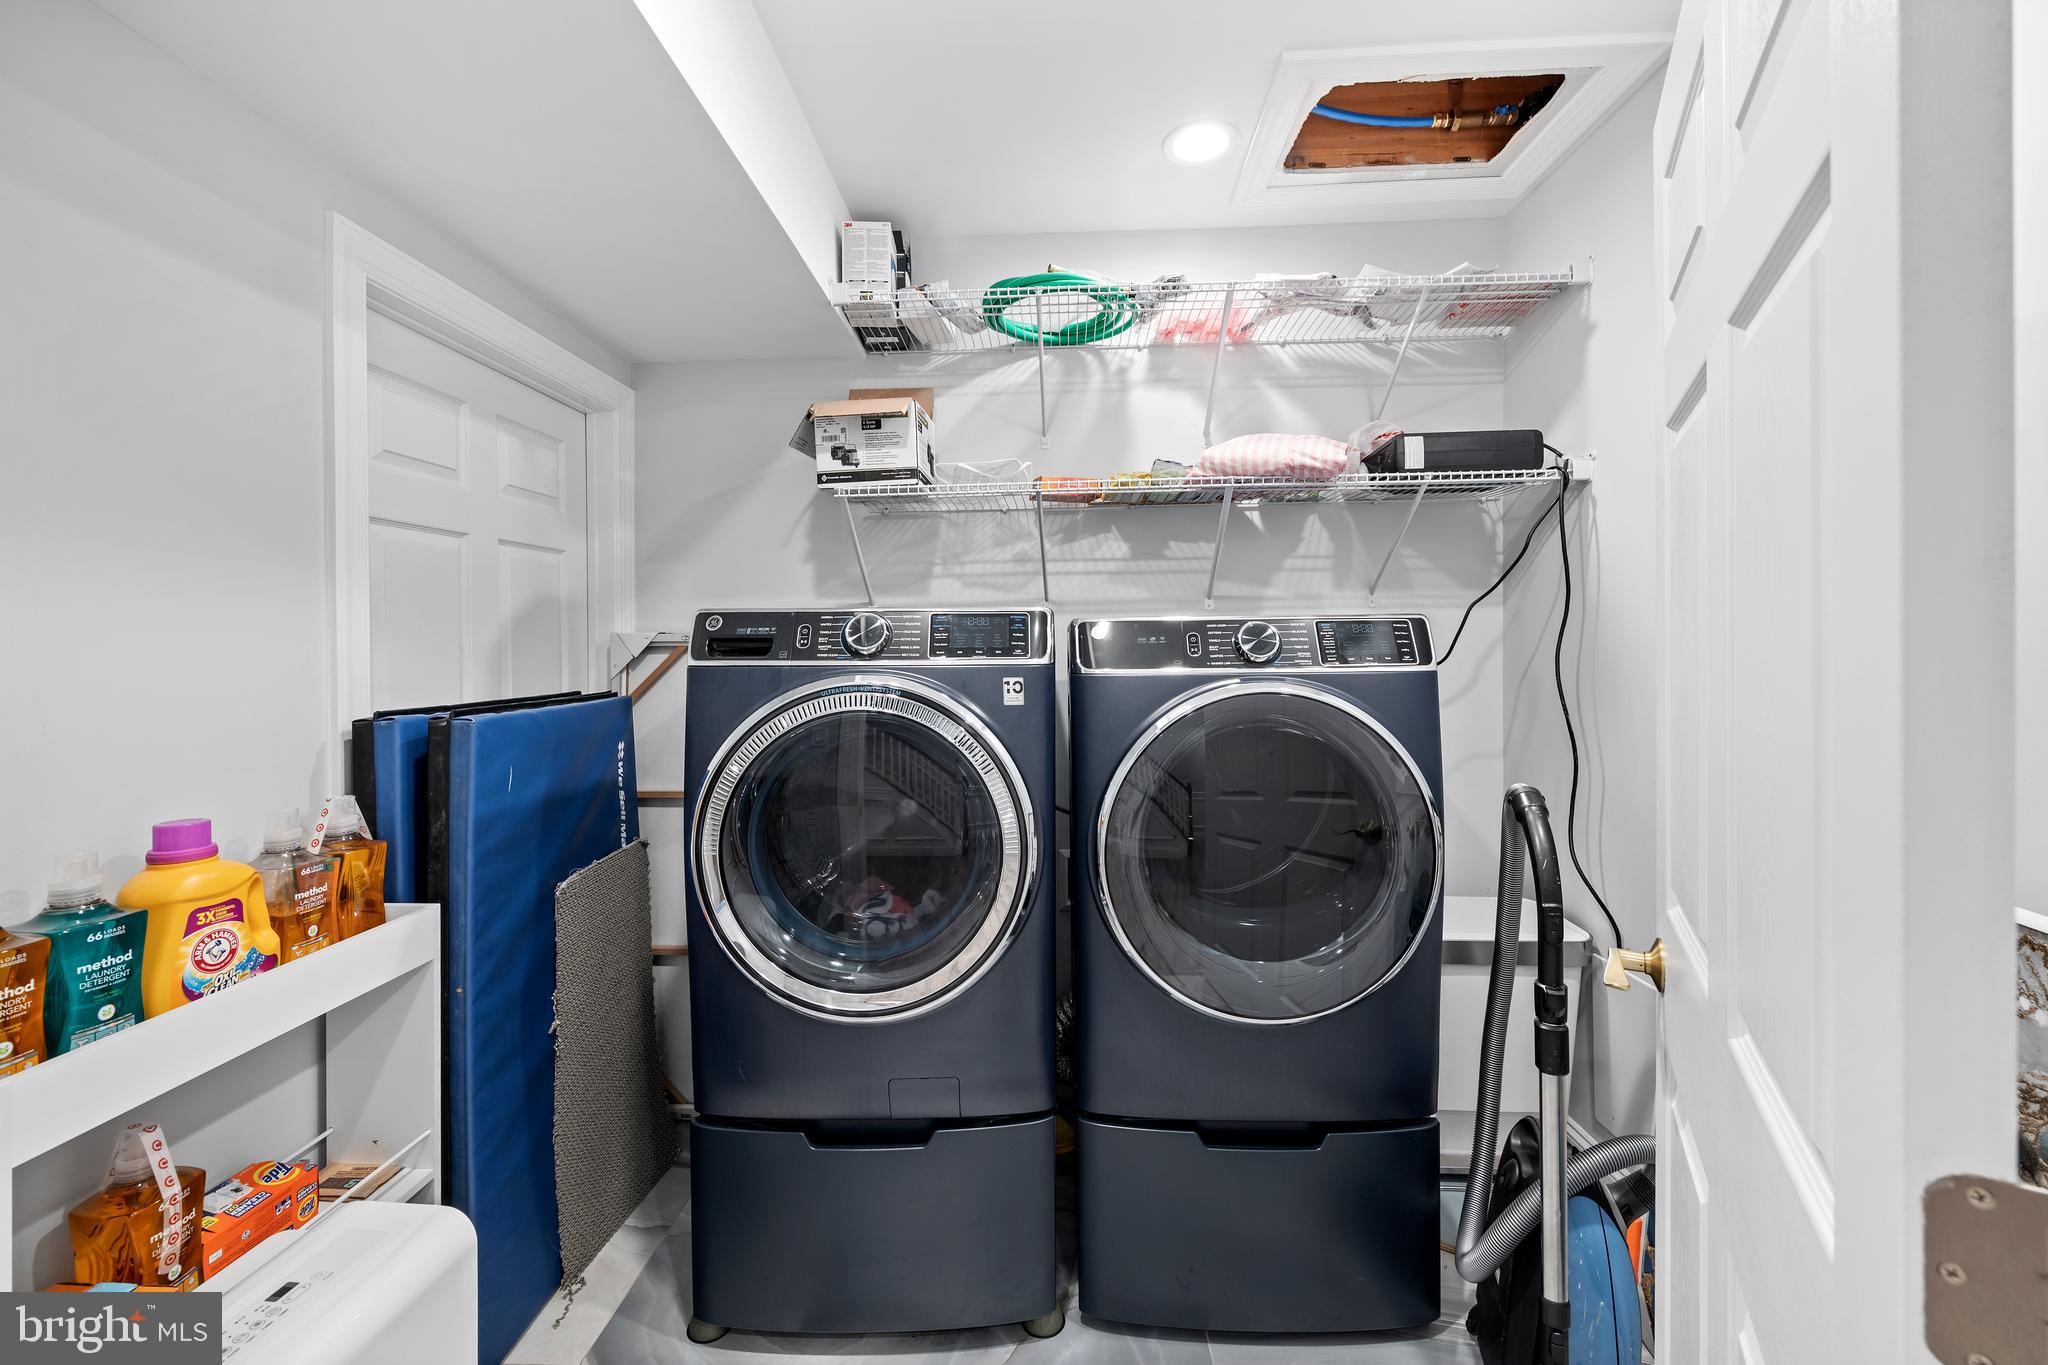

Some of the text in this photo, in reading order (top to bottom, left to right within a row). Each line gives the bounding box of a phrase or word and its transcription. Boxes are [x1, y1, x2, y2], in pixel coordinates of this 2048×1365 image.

[301, 867, 311, 876] 66
[295, 882, 329, 901] method
[196, 910, 216, 926] 3X
[86, 925, 126, 942] 66 LOADS
[194, 941, 206, 960] ARM
[212, 931, 238, 949] HAMMER
[76, 949, 133, 975] method
[79, 968, 131, 990] DETERGENT
[85, 963, 127, 981] LAUNDRY
[0, 978, 36, 1000] thod
[0, 994, 28, 1010] NDRY
[0, 1001, 33, 1018] RGENT
[261, 1162, 294, 1184] Tide
